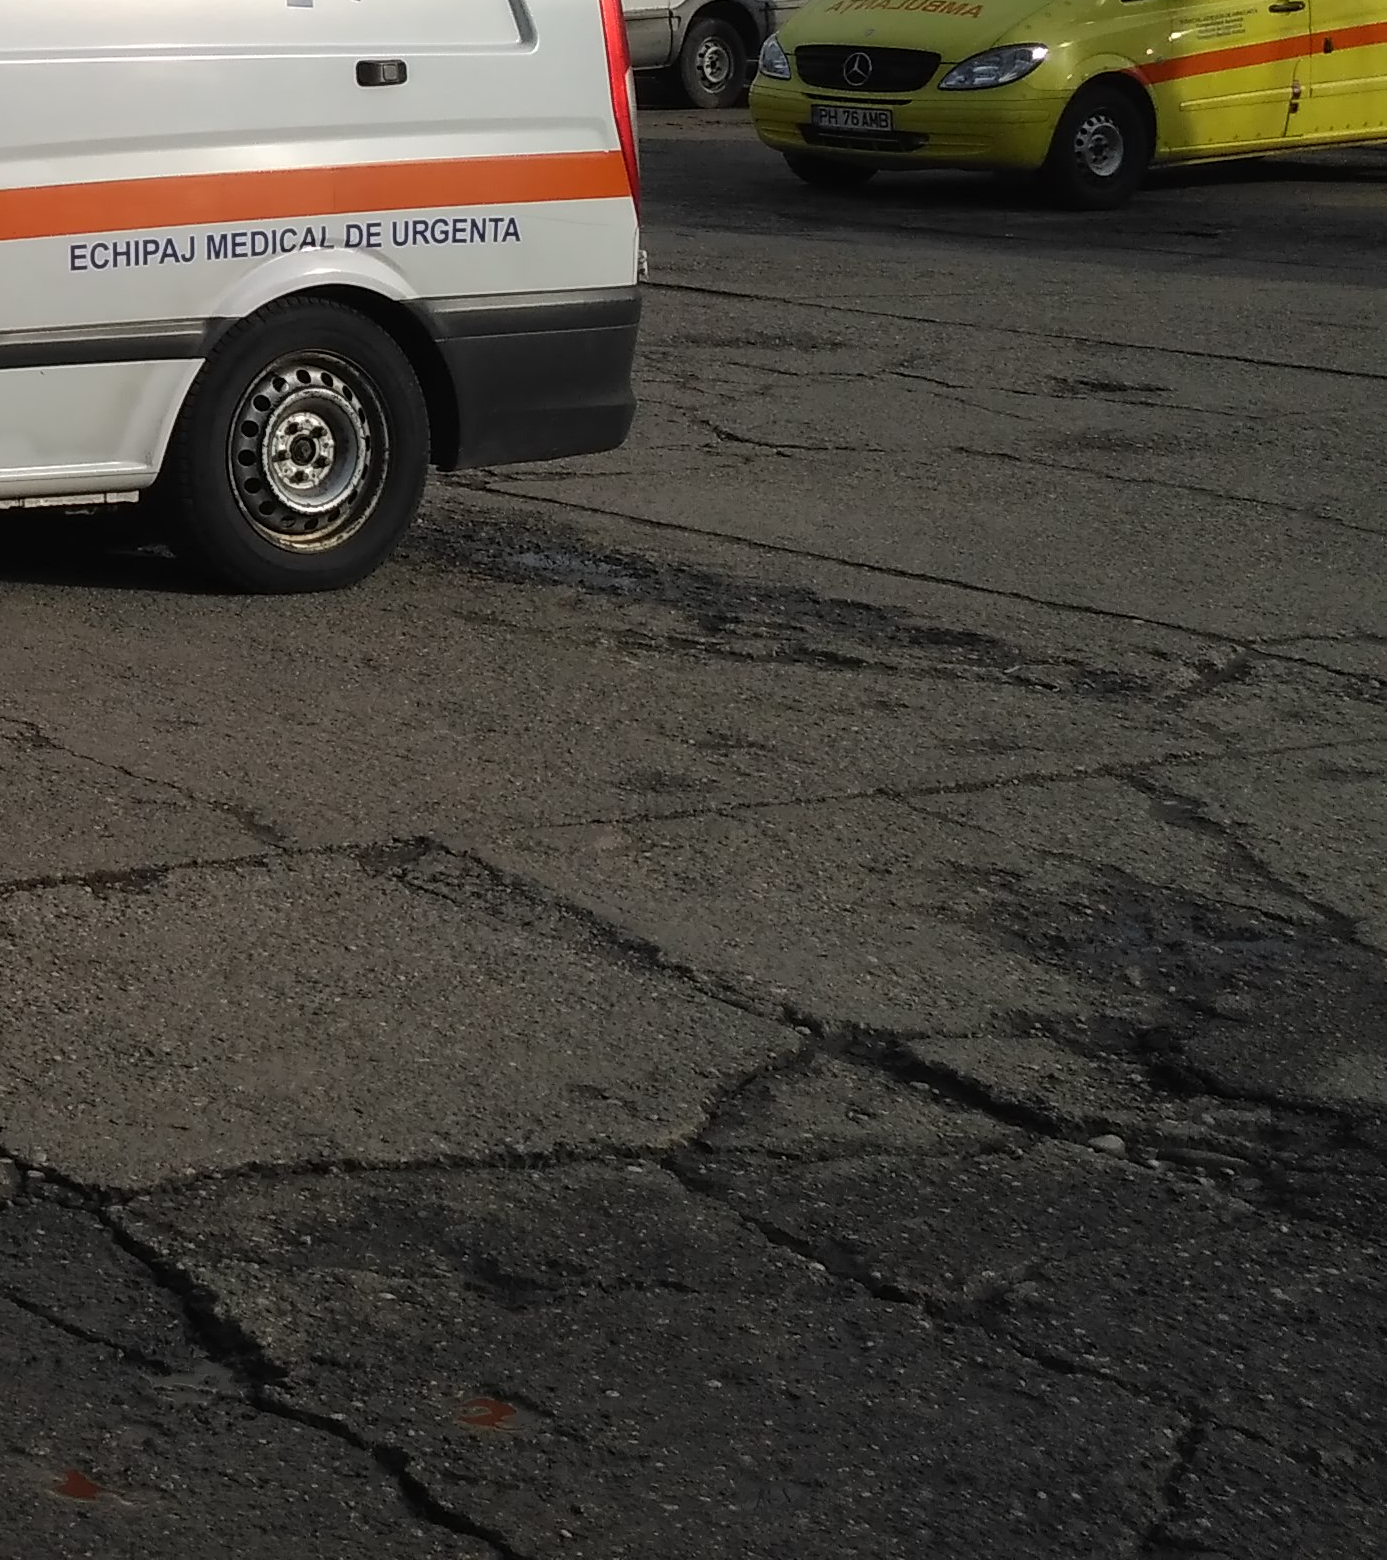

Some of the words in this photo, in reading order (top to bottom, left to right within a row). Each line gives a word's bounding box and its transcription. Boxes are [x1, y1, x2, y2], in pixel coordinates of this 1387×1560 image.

[820, 109, 838, 125] PH
[843, 110, 858, 126] 76
[862, 112, 890, 128] AMB
[69, 236, 195, 271] ECHIPAJ
[206, 226, 341, 261] MEDICAL
[345, 221, 383, 248] DE
[392, 216, 521, 247] URGENTA
